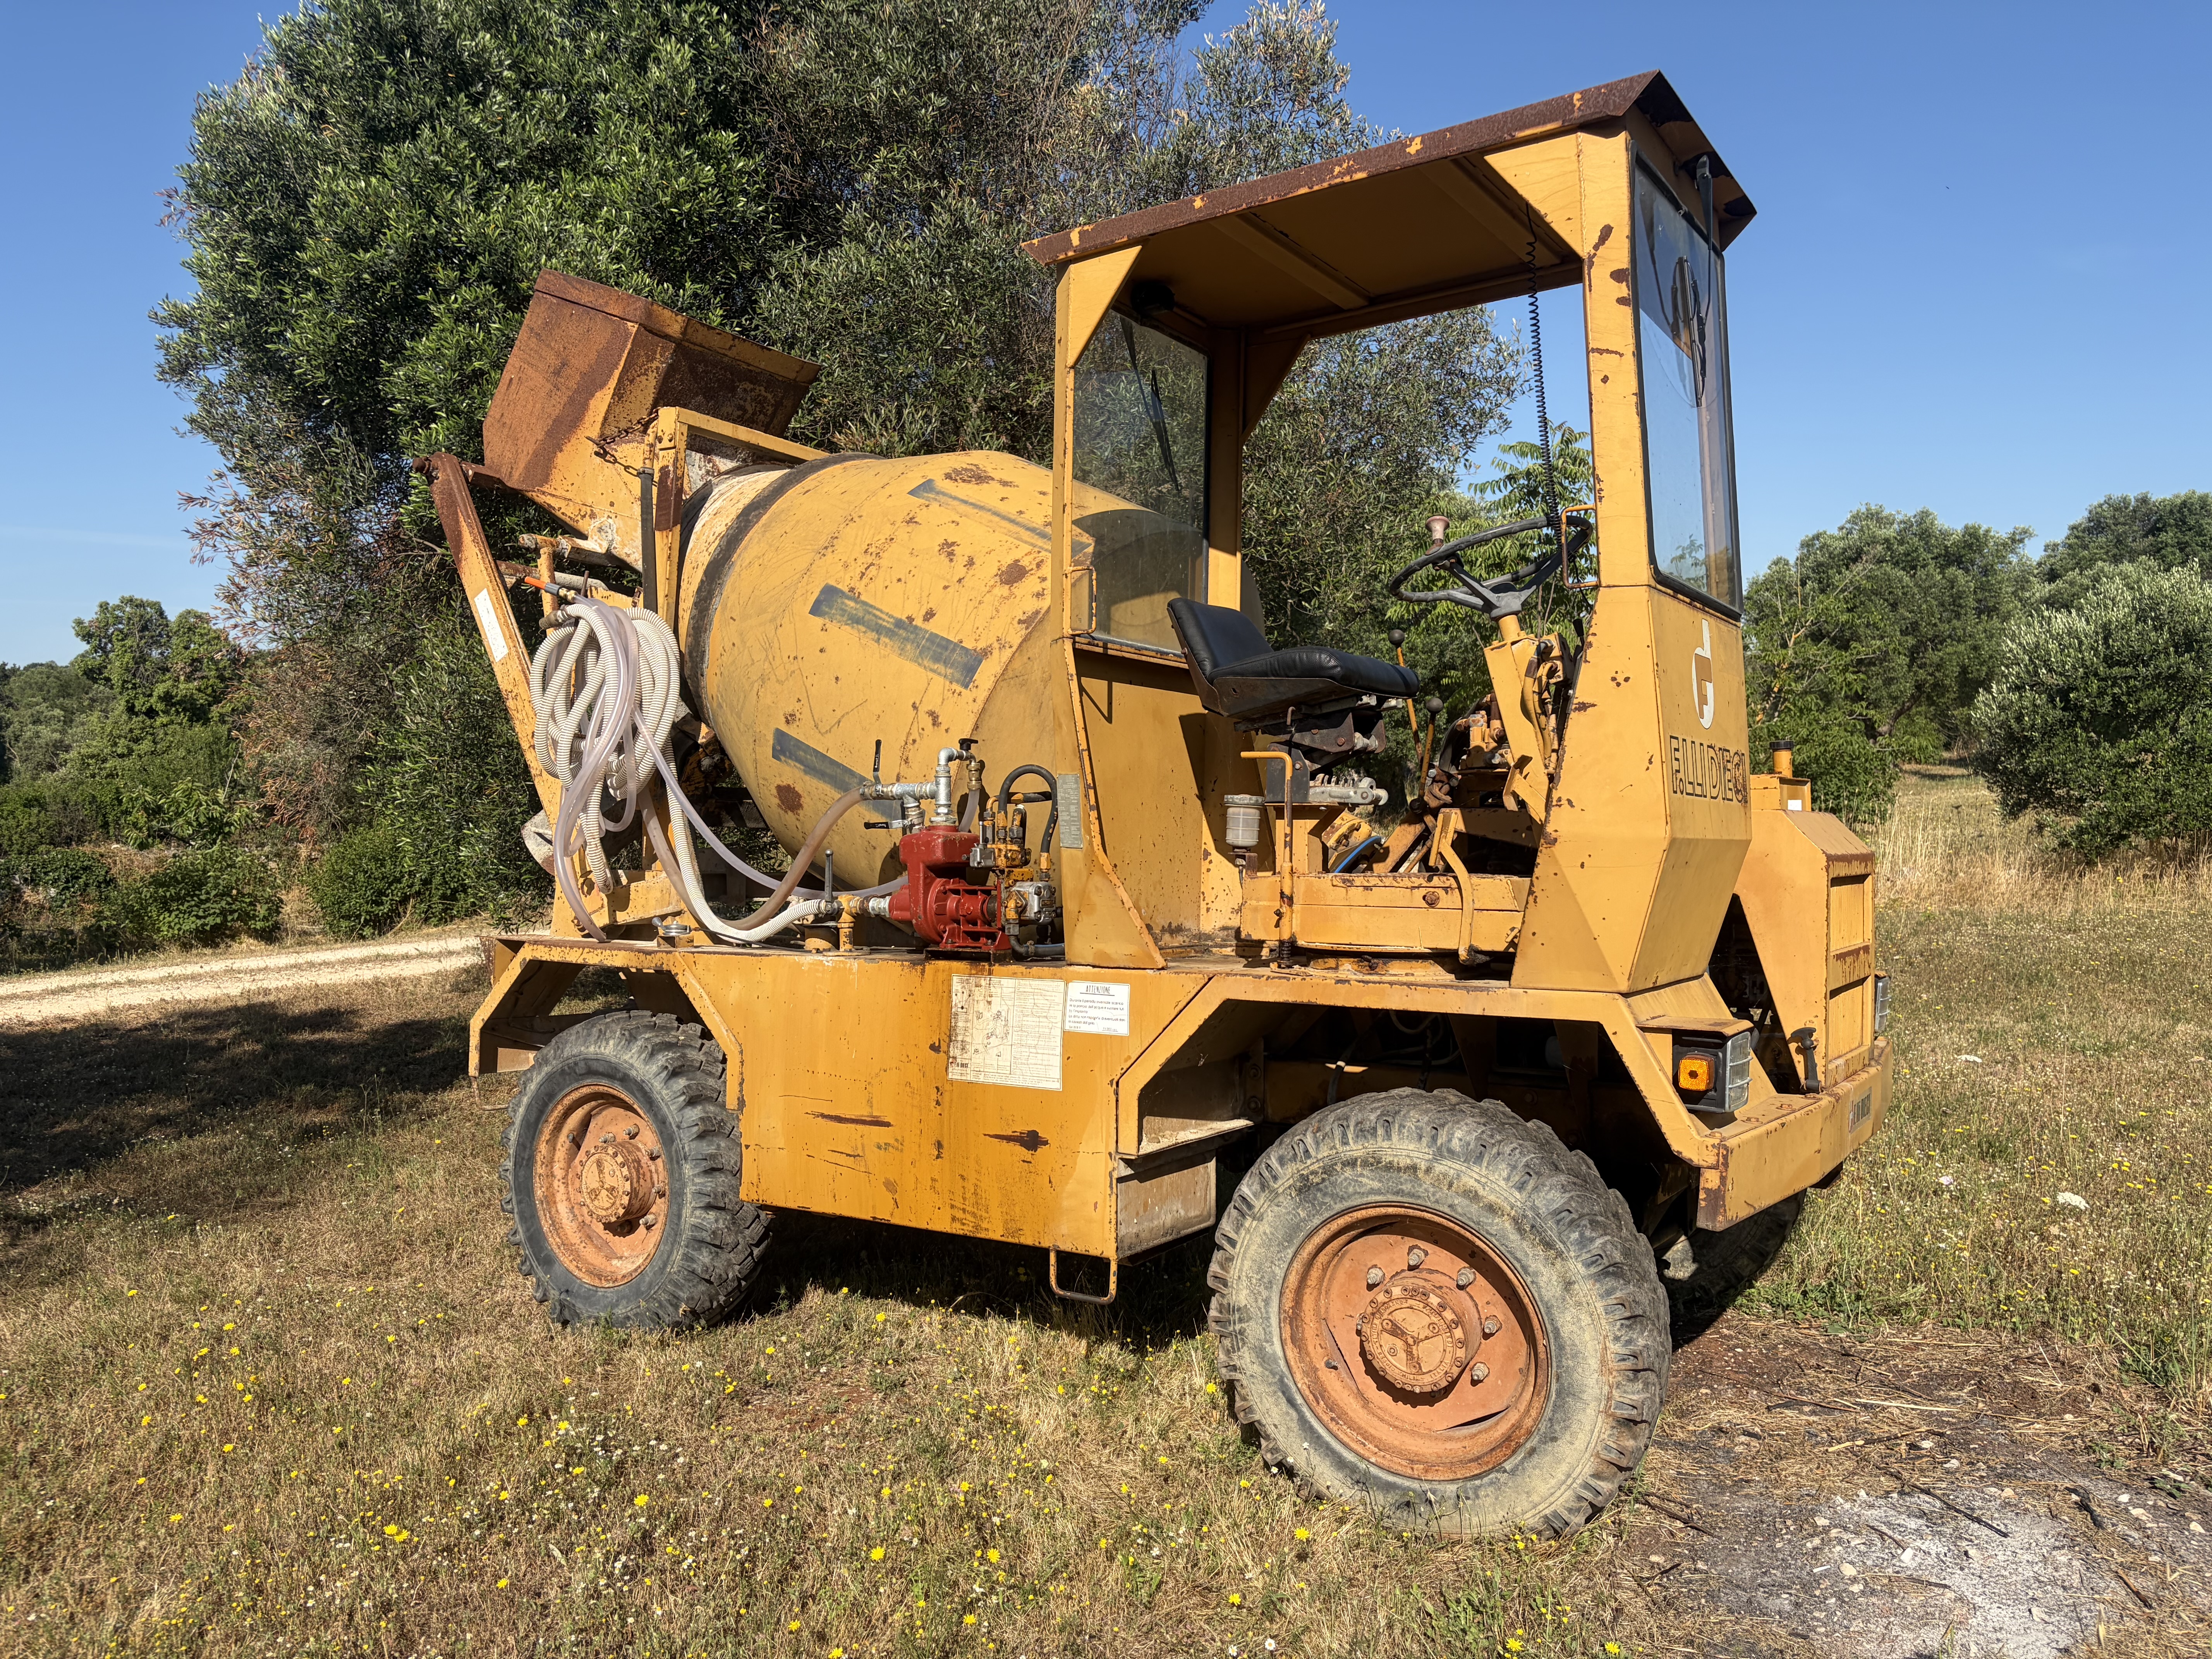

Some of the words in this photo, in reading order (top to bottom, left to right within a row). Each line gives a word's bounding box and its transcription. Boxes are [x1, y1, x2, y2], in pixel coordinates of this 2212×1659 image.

[1669, 735, 1707, 798] F.LLI
[1707, 744, 1748, 804] DIECI
[1085, 985, 1111, 994] ATTENZIONE
